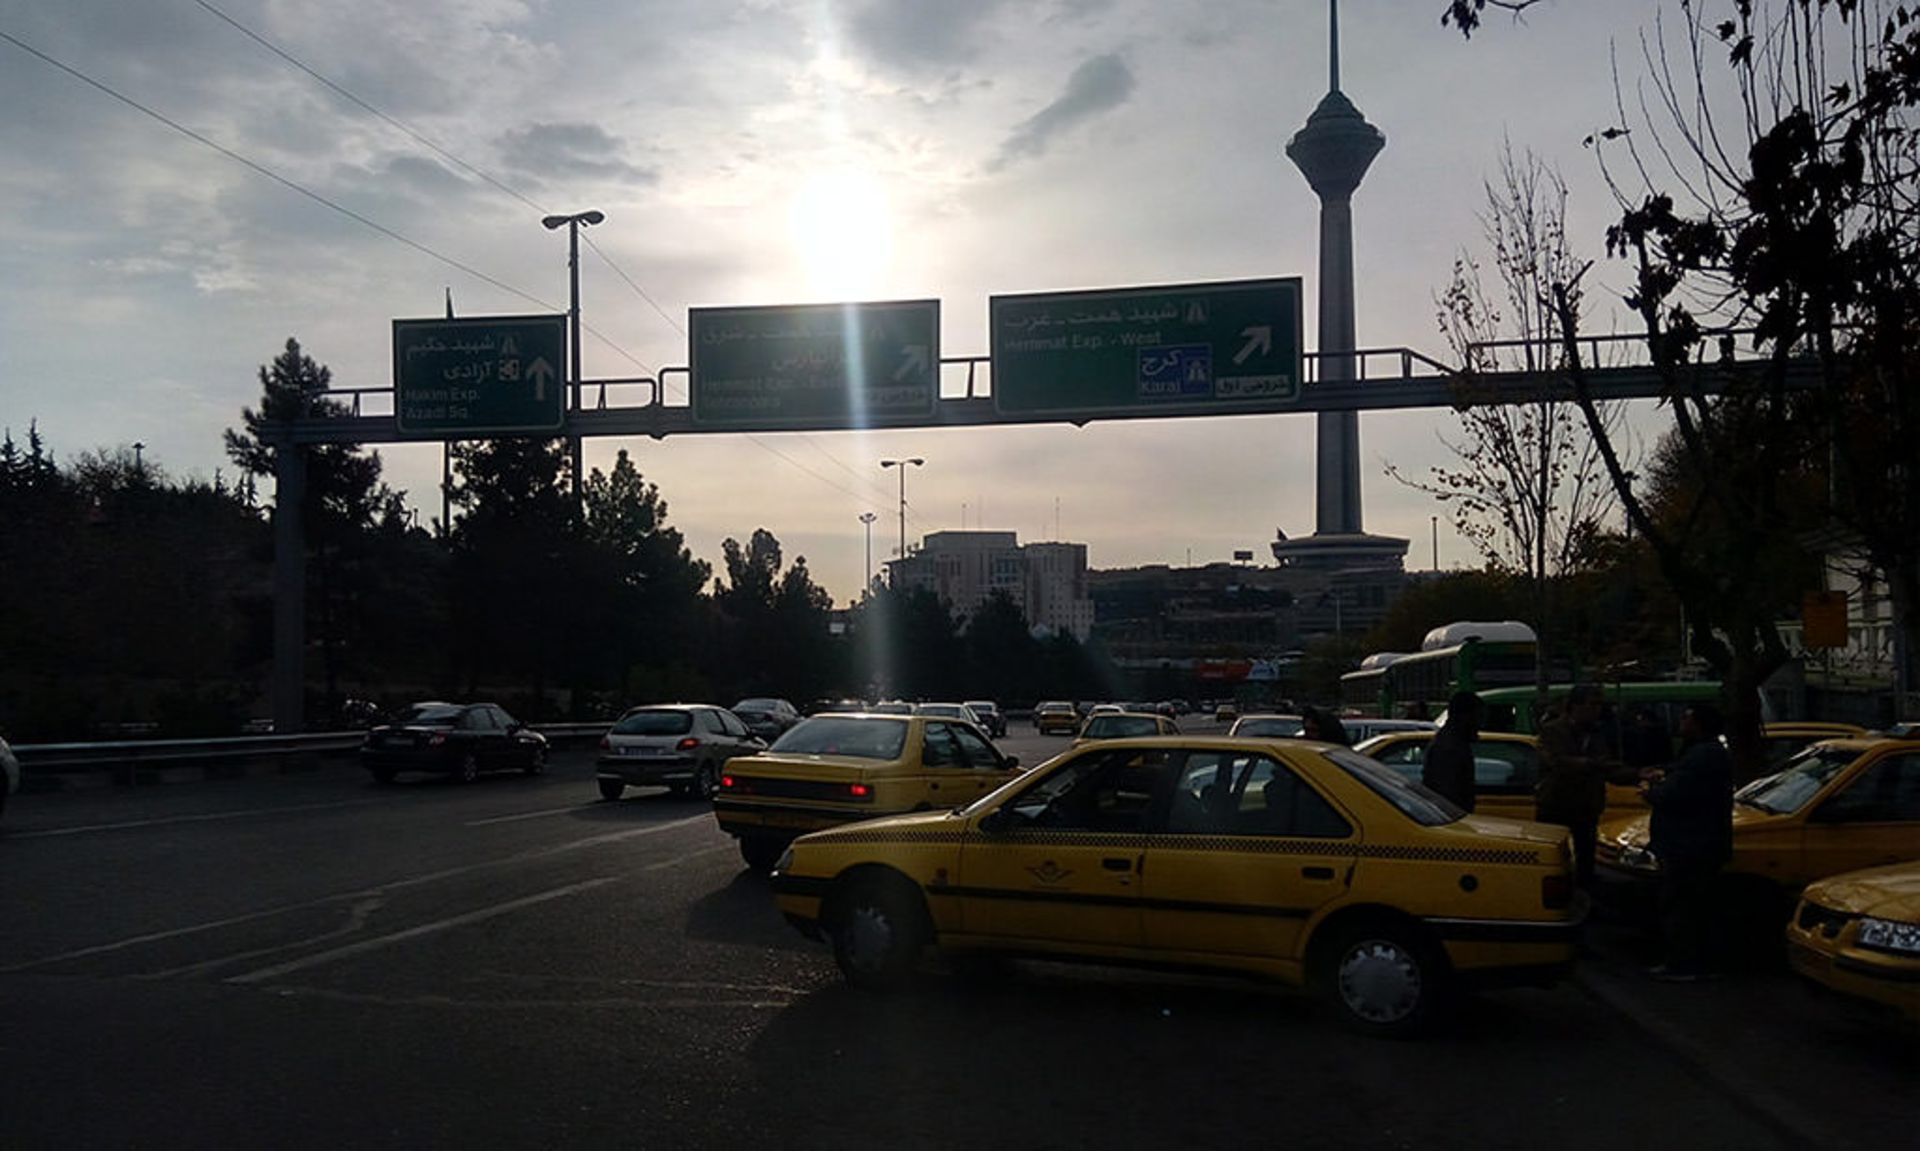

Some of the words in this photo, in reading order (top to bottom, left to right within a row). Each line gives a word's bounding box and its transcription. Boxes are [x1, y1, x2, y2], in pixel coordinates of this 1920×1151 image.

[449, 334, 496, 355] شهید
[443, 360, 492, 385] آزادی
[1140, 349, 1184, 377] کرج
